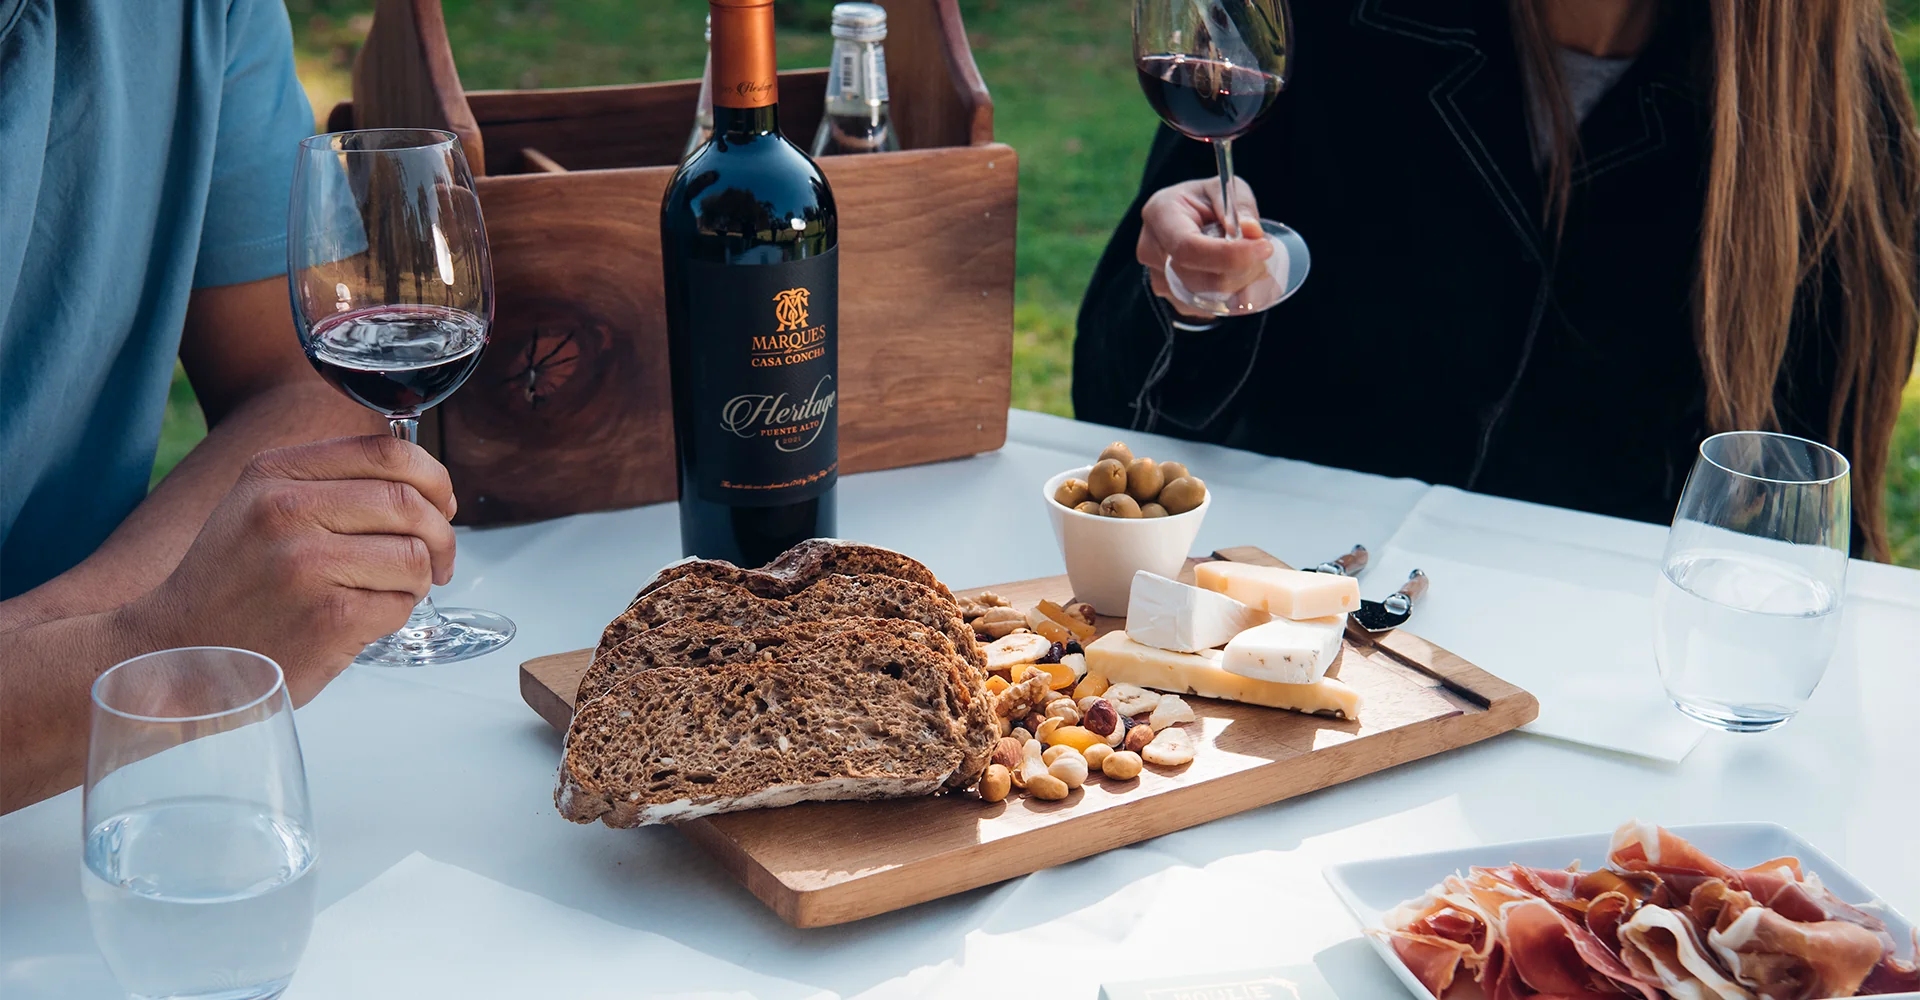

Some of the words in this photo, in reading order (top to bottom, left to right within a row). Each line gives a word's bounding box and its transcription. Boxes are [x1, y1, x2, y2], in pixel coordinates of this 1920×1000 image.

[751, 324, 826, 351] MARQUES
[751, 357, 783, 367] CASA
[785, 346, 825, 365] CONCHA
[719, 374, 836, 452] Heritage
[760, 425, 798, 436] PUENTE
[799, 420, 820, 431] ALTO
